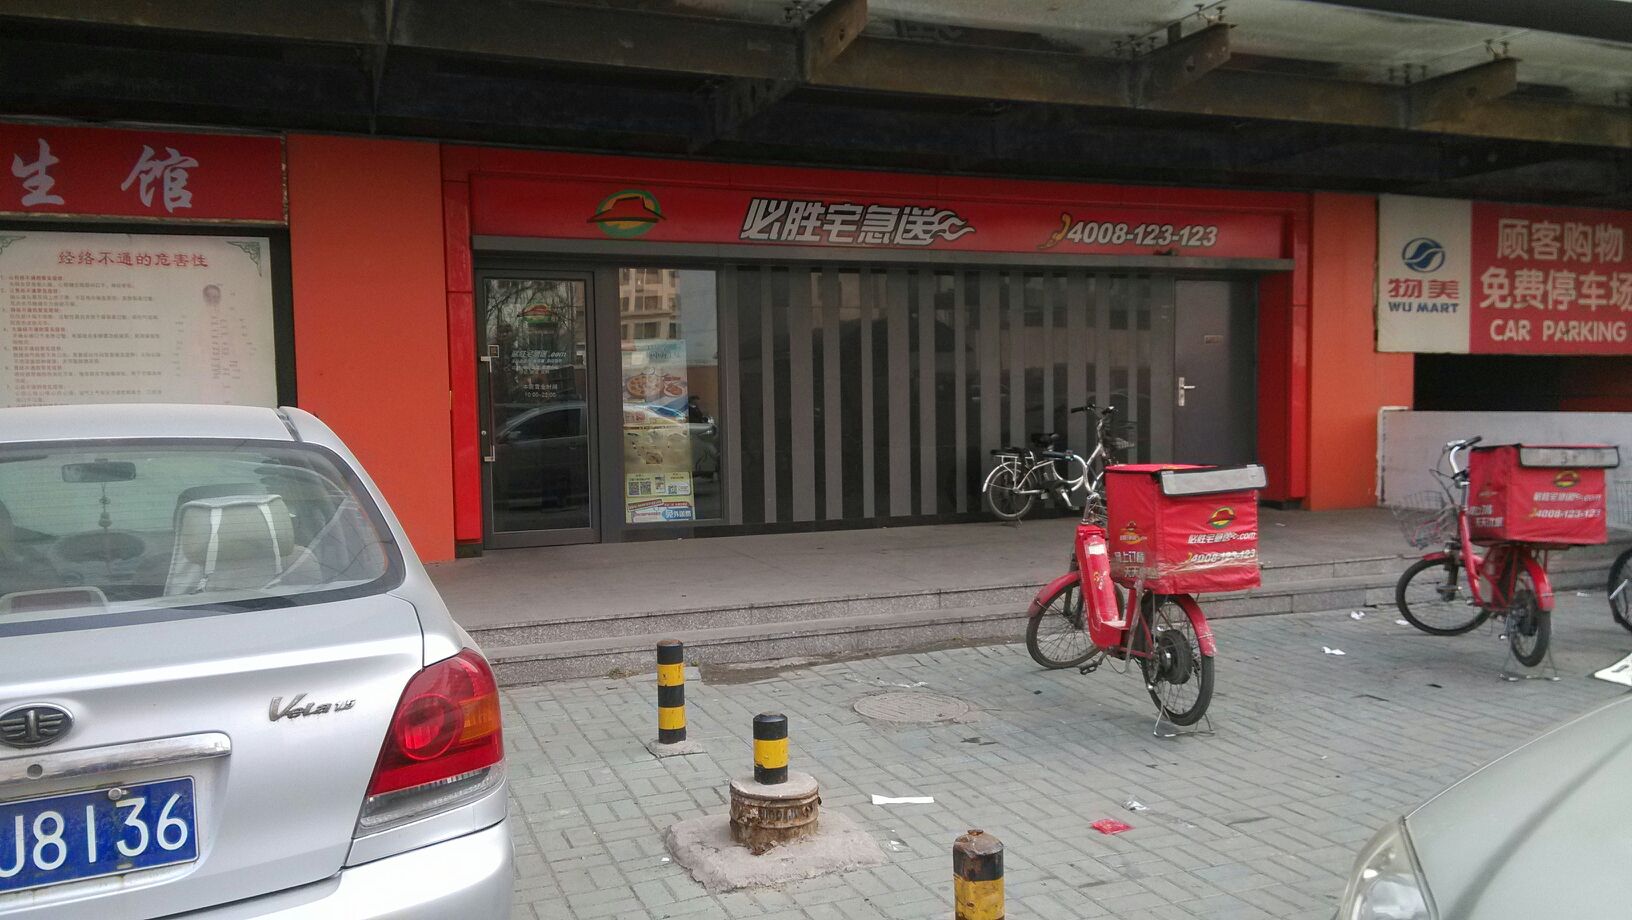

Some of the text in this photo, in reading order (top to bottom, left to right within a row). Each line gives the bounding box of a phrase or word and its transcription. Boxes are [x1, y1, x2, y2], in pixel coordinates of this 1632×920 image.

[739, 197, 940, 247] 必胜宅急送
[1066, 220, 1219, 248] 4008-123-123
[1497, 217, 1624, 263] 顾客购物
[58, 250, 209, 268] 经络不通的危害性
[1388, 277, 1460, 300] 物美
[1388, 301, 1459, 315] WU MART
[1489, 319, 1627, 344] CAR PARKING
